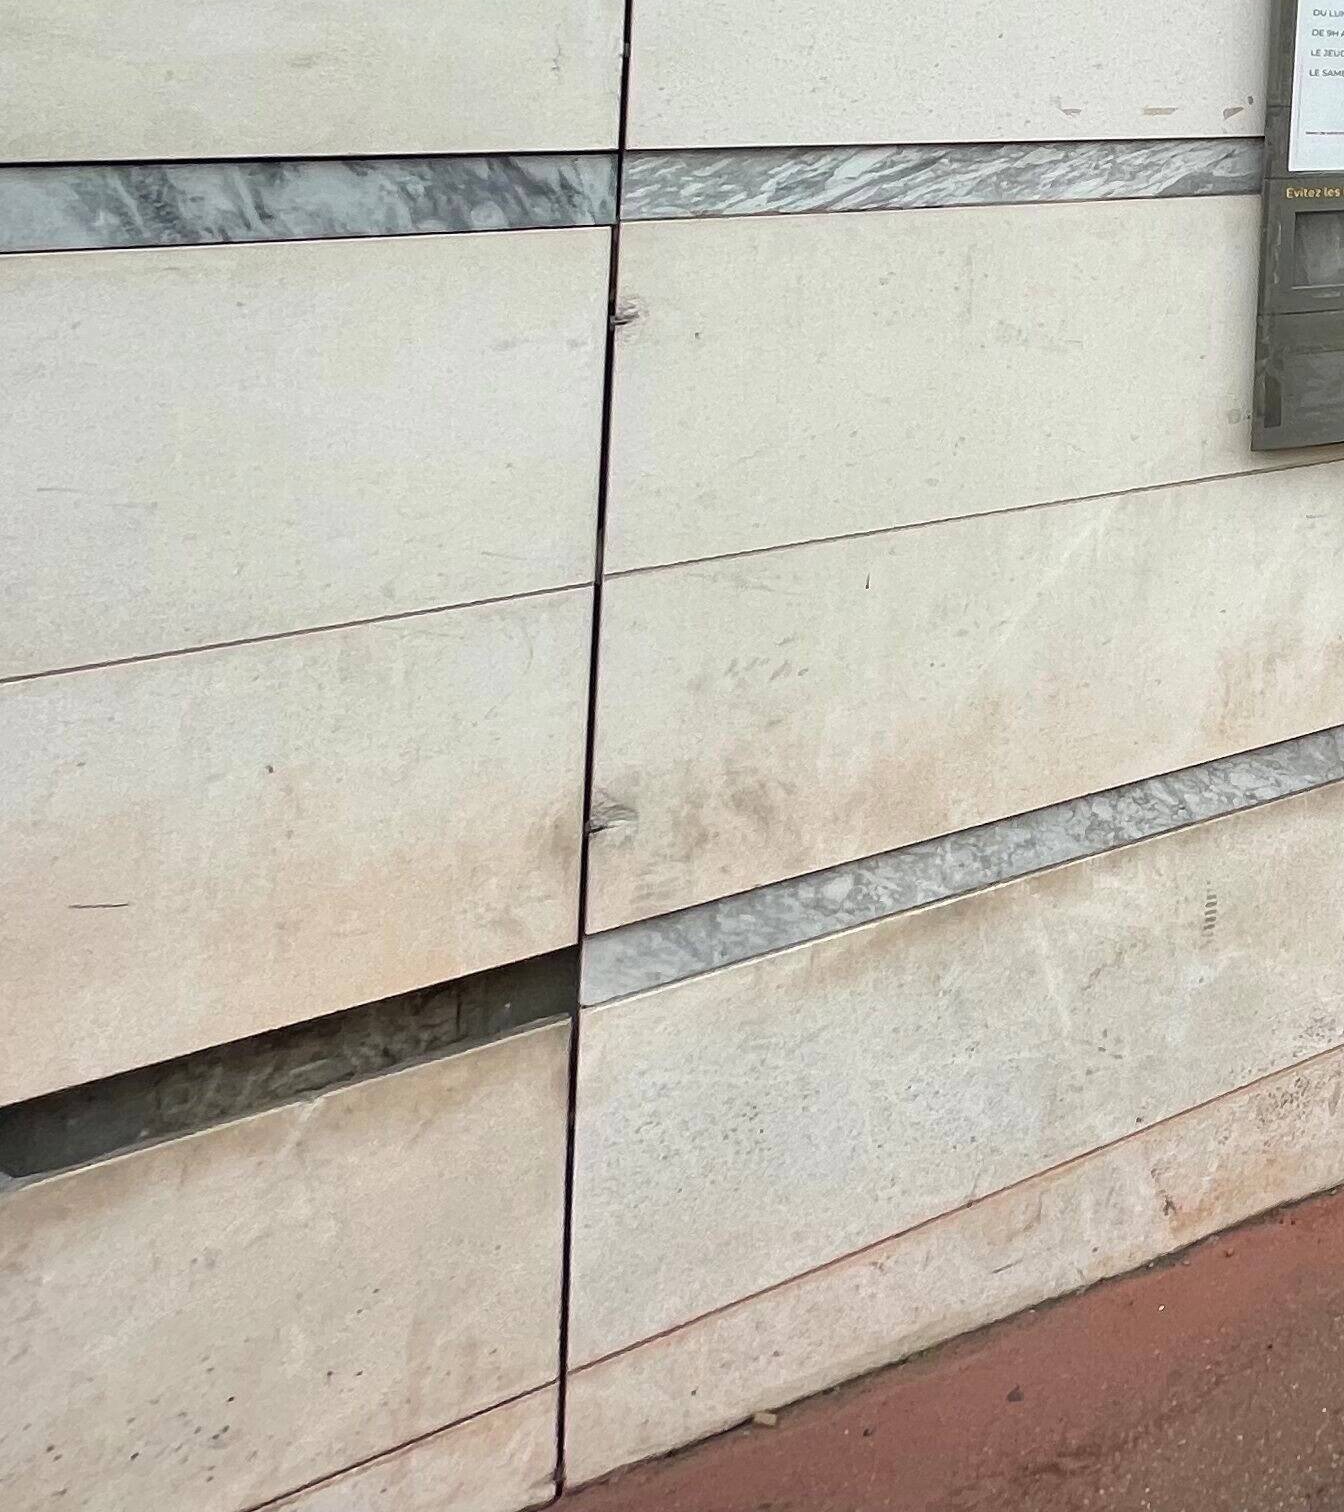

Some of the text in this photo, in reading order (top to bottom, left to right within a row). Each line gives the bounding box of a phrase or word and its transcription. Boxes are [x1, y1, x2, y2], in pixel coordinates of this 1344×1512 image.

[1313, 9, 1326, 17] DU
[1311, 29, 1324, 37] DE
[1324, 187, 1341, 198] les
